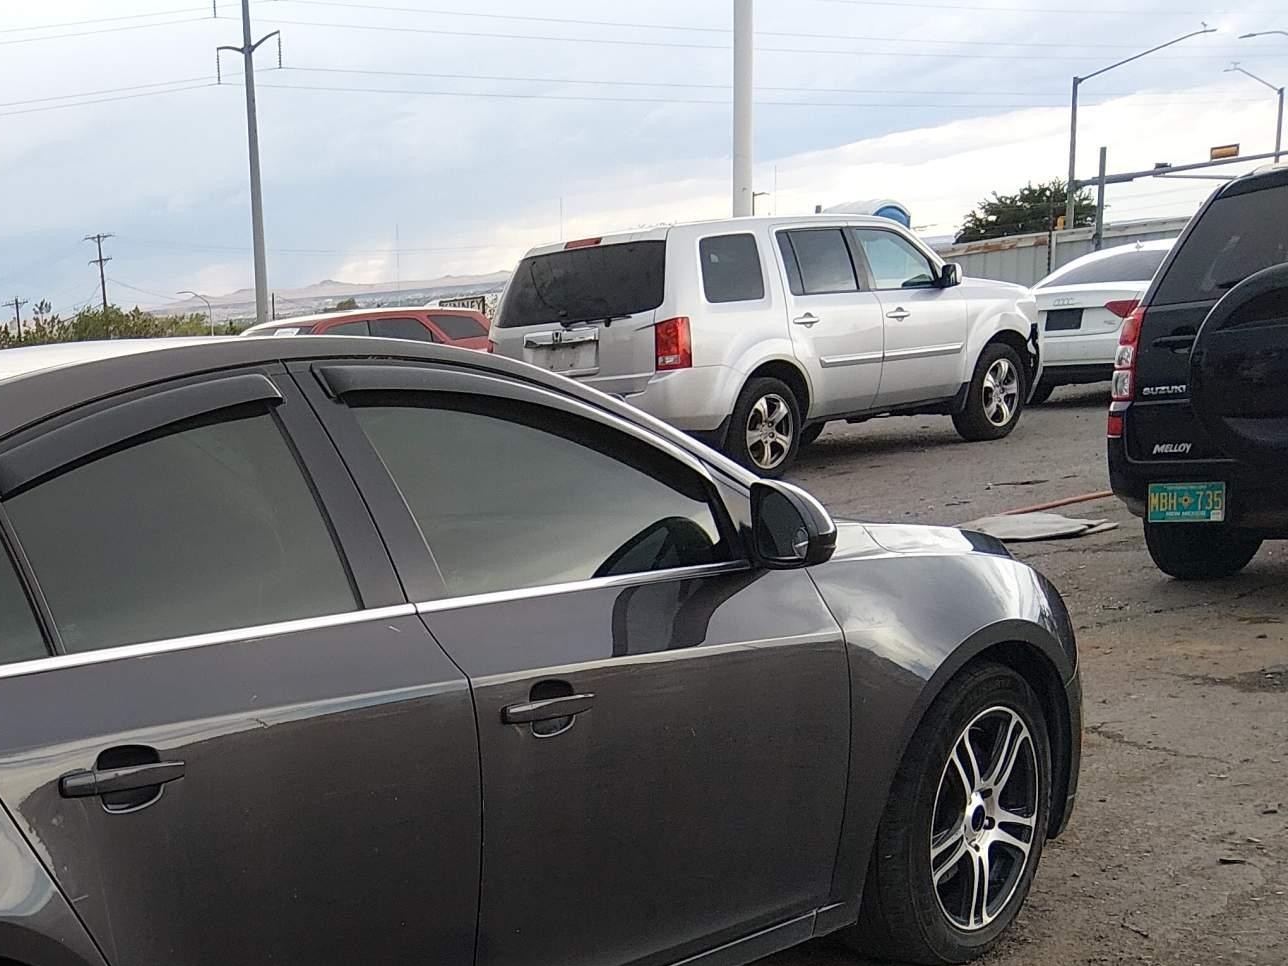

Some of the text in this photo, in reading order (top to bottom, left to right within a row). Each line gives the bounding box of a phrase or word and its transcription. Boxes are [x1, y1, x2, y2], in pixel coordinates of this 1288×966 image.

[1142, 384, 1187, 396] SUZUKI
[1152, 443, 1192, 455] MELLOY
[1150, 490, 1223, 513] MBH 735
